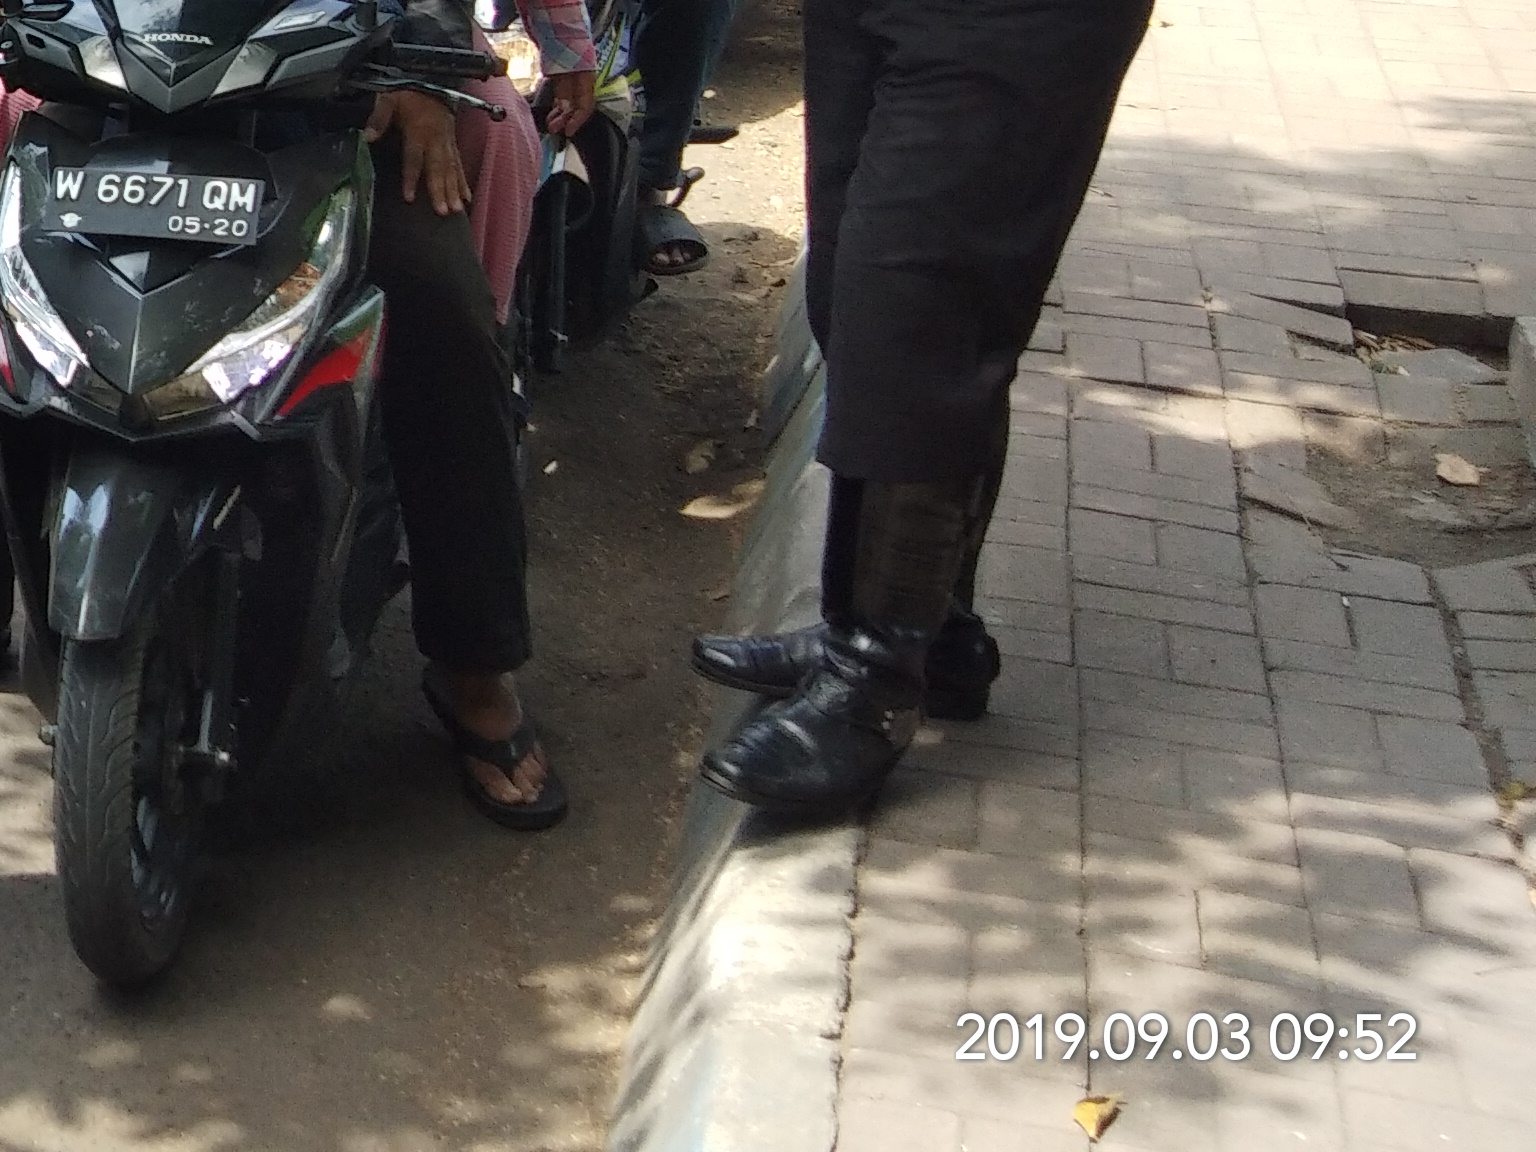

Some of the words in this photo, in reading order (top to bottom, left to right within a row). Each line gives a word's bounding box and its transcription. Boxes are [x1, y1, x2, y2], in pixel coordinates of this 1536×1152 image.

[142, 33, 215, 46] HONDA
[55, 169, 85, 201] W
[97, 173, 190, 209] 6671
[202, 179, 257, 213] QM
